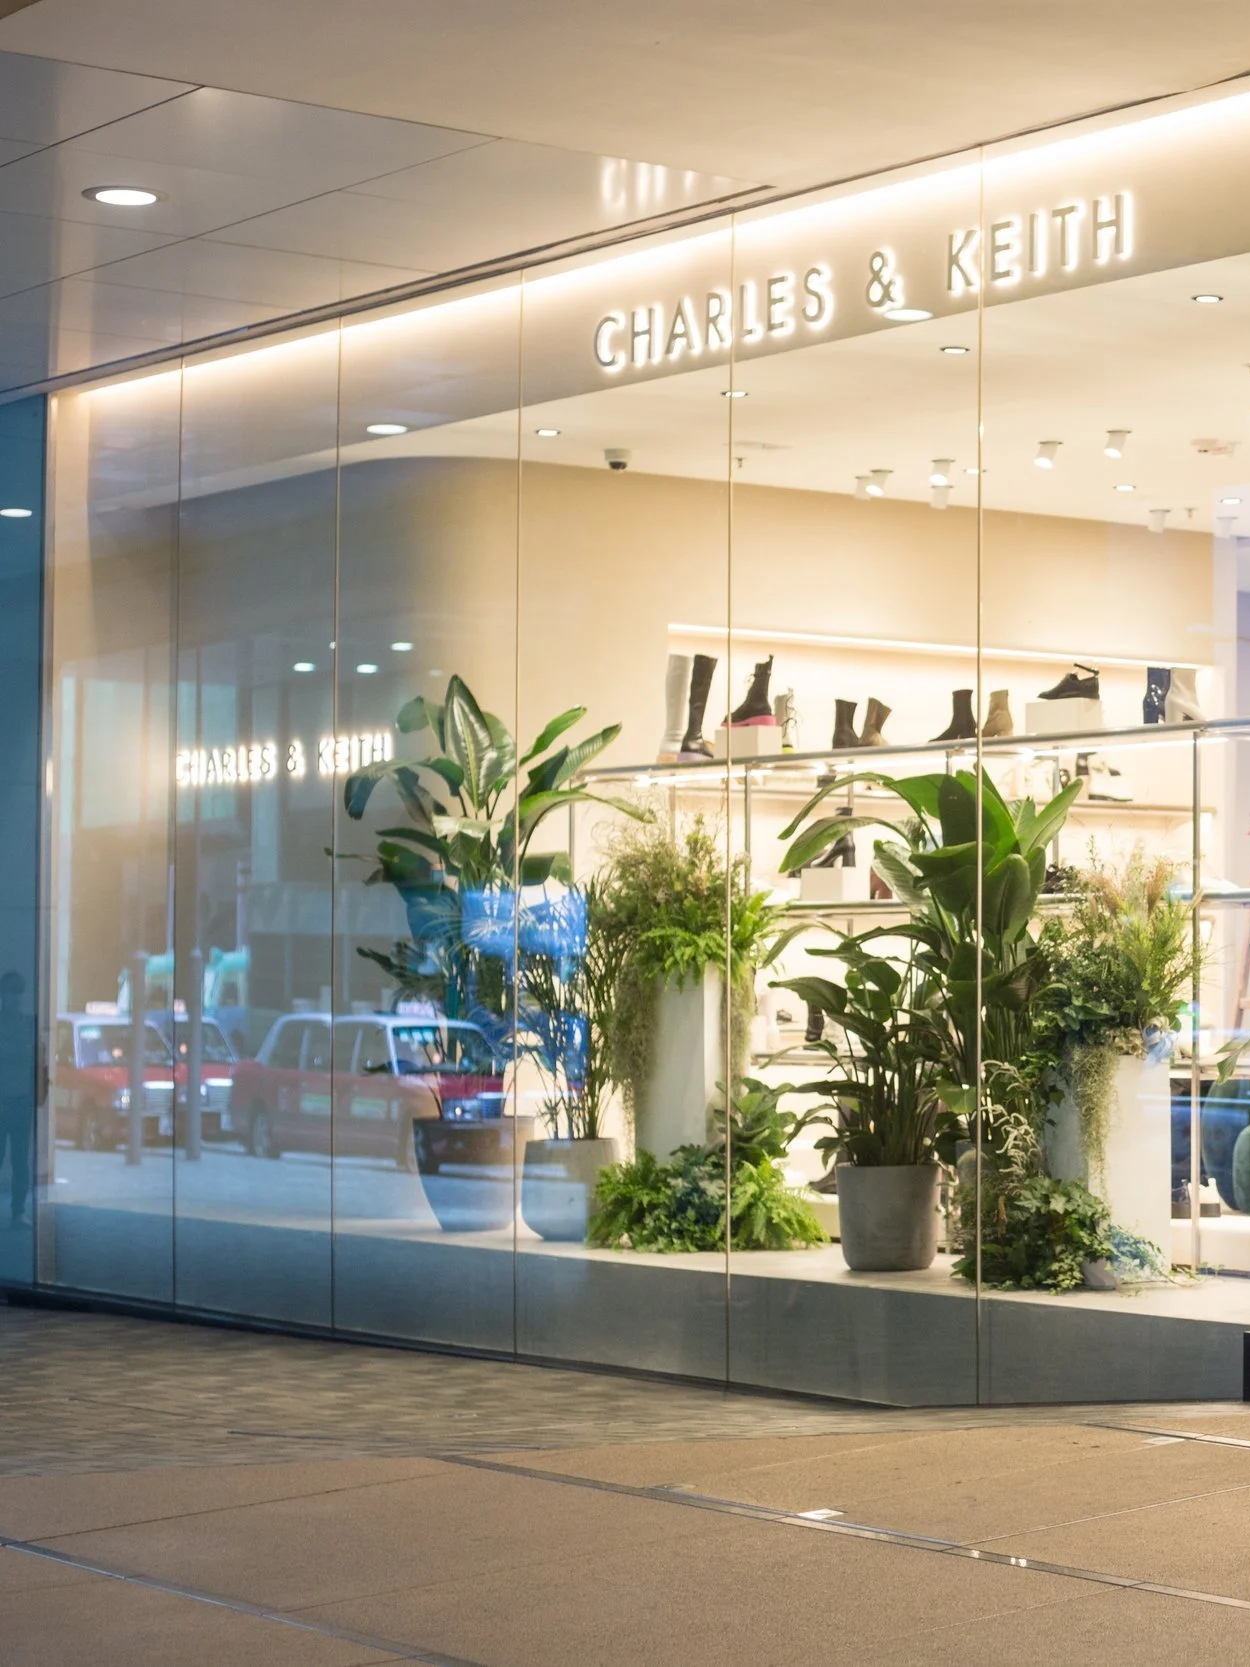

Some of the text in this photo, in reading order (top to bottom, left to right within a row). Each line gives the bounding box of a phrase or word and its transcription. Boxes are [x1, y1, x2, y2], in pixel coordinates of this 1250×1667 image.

[594, 194, 1131, 368] CHARLES & KEITH
[176, 733, 393, 785] CHARLES & KEITH
